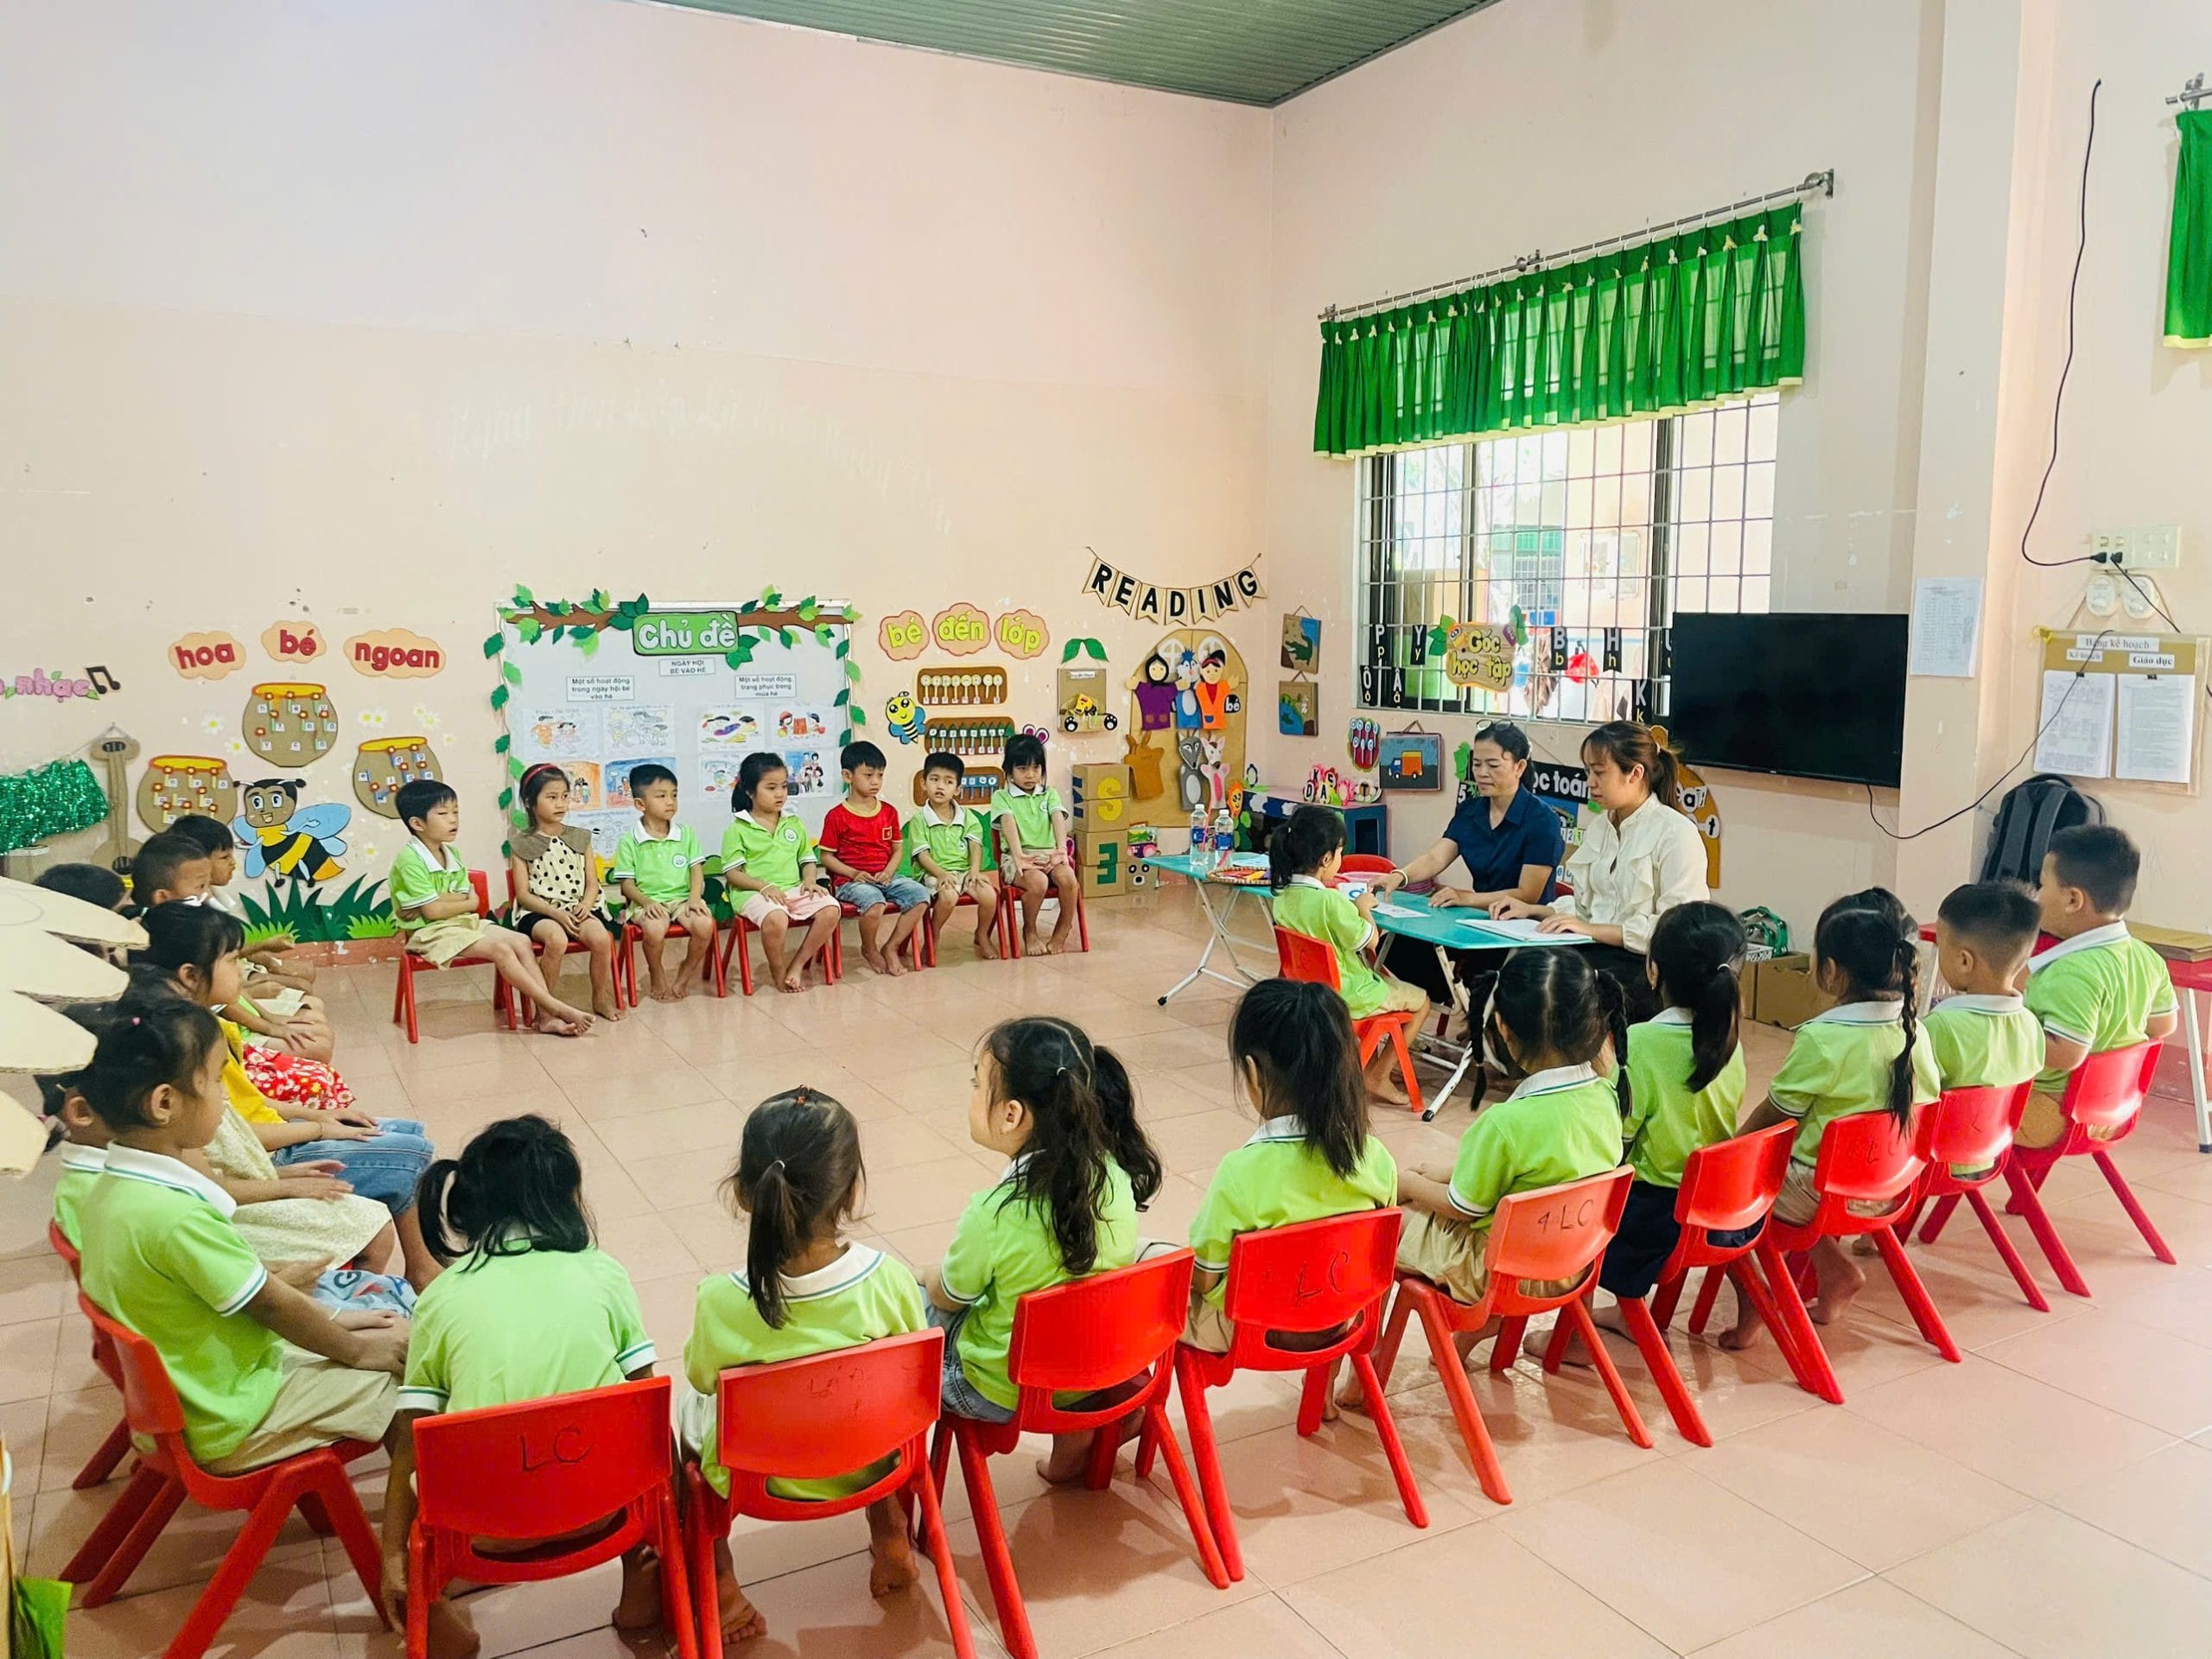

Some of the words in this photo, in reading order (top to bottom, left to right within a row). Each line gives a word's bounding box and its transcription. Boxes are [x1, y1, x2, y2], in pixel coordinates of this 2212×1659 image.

[1091, 563, 1257, 616] READING
[639, 619, 692, 649] Chủ
[699, 613, 736, 648] đề
[887, 616, 922, 648] bé
[938, 611, 983, 641] đến
[1001, 616, 1040, 654] lớp
[1469, 628, 1501, 653] Góc
[2086, 638, 2107, 647] Bng
[175, 643, 235, 670] hoa
[280, 628, 316, 656] bé
[355, 642, 440, 671] ngoan
[15, 668, 90, 702] nhạc
[1452, 651, 1478, 679] học
[1486, 655, 1512, 686] tập
[1225, 696, 1240, 711] bé
